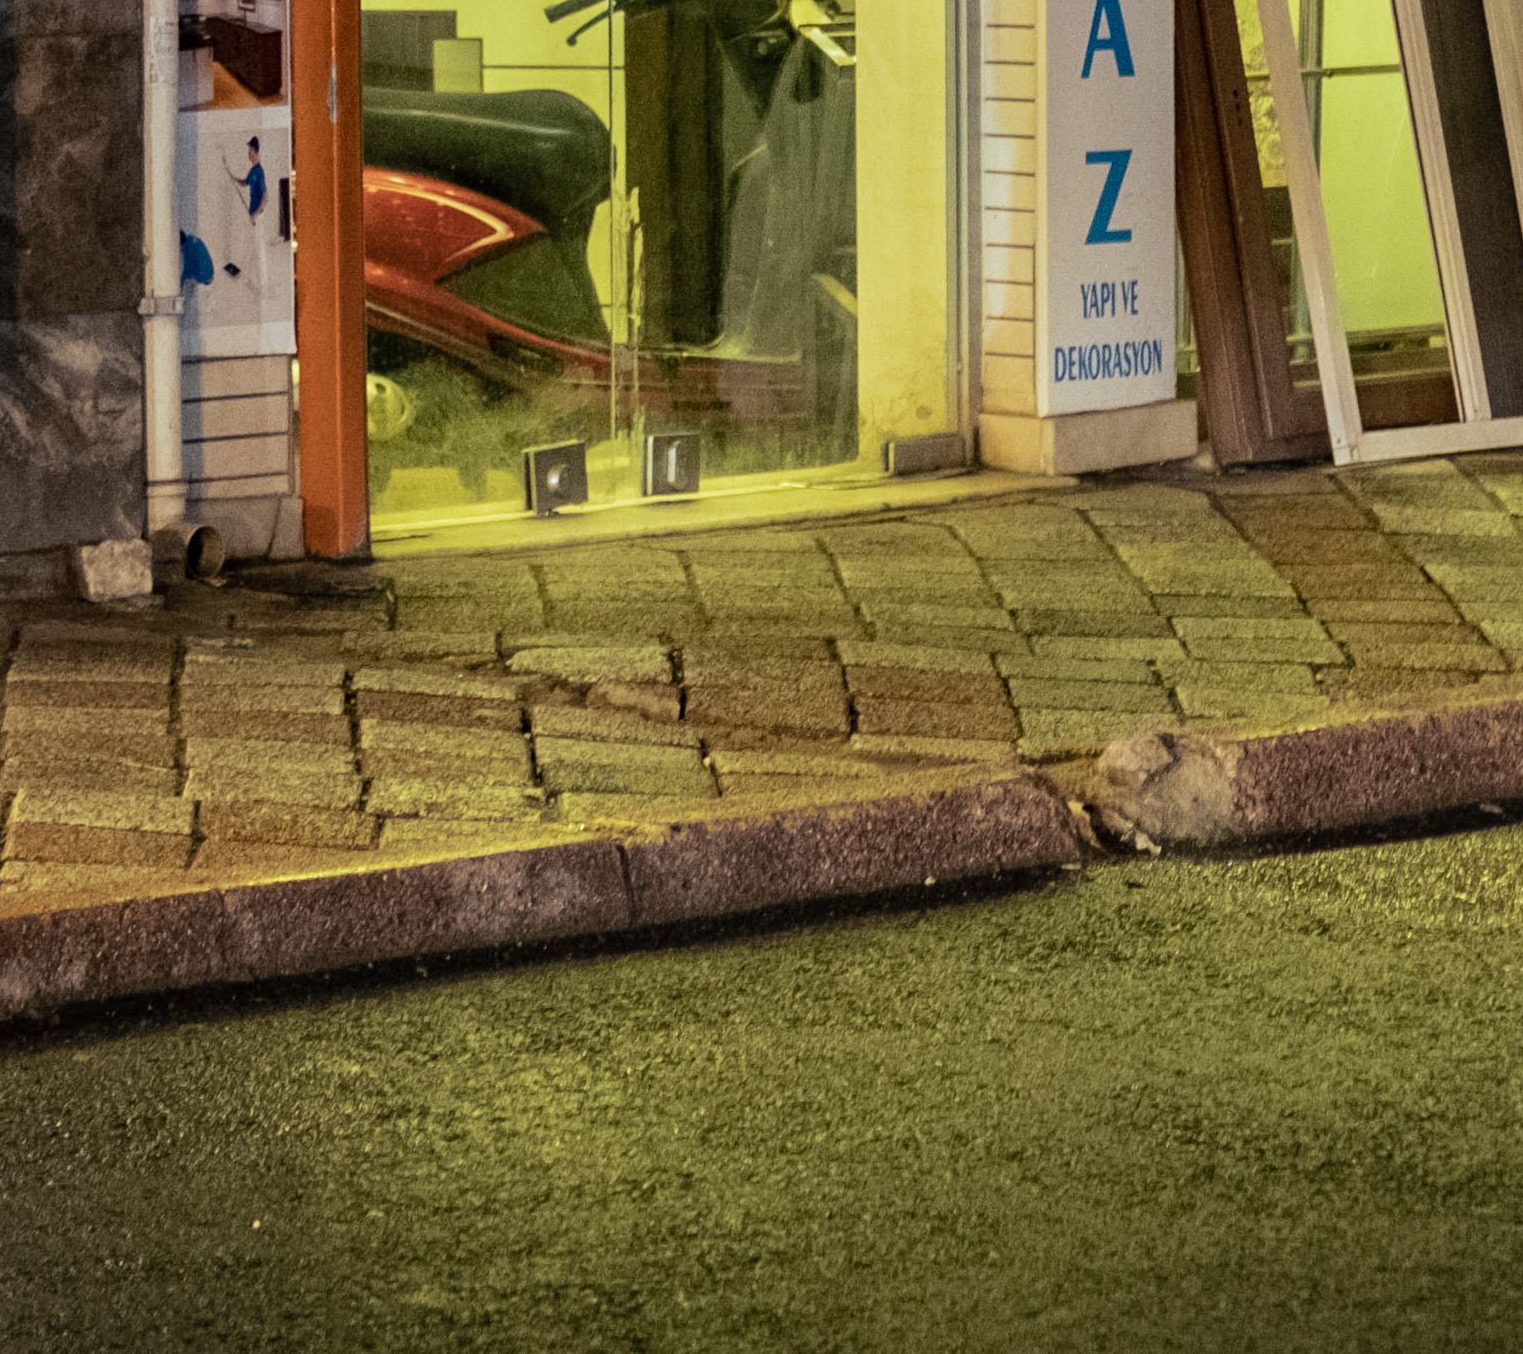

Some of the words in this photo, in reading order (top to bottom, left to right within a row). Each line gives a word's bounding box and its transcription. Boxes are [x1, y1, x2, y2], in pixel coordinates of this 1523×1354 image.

[1080, 281, 1116, 319] YAPI
[1121, 278, 1139, 316] VE
[1054, 338, 1163, 384] DEKORASYON
